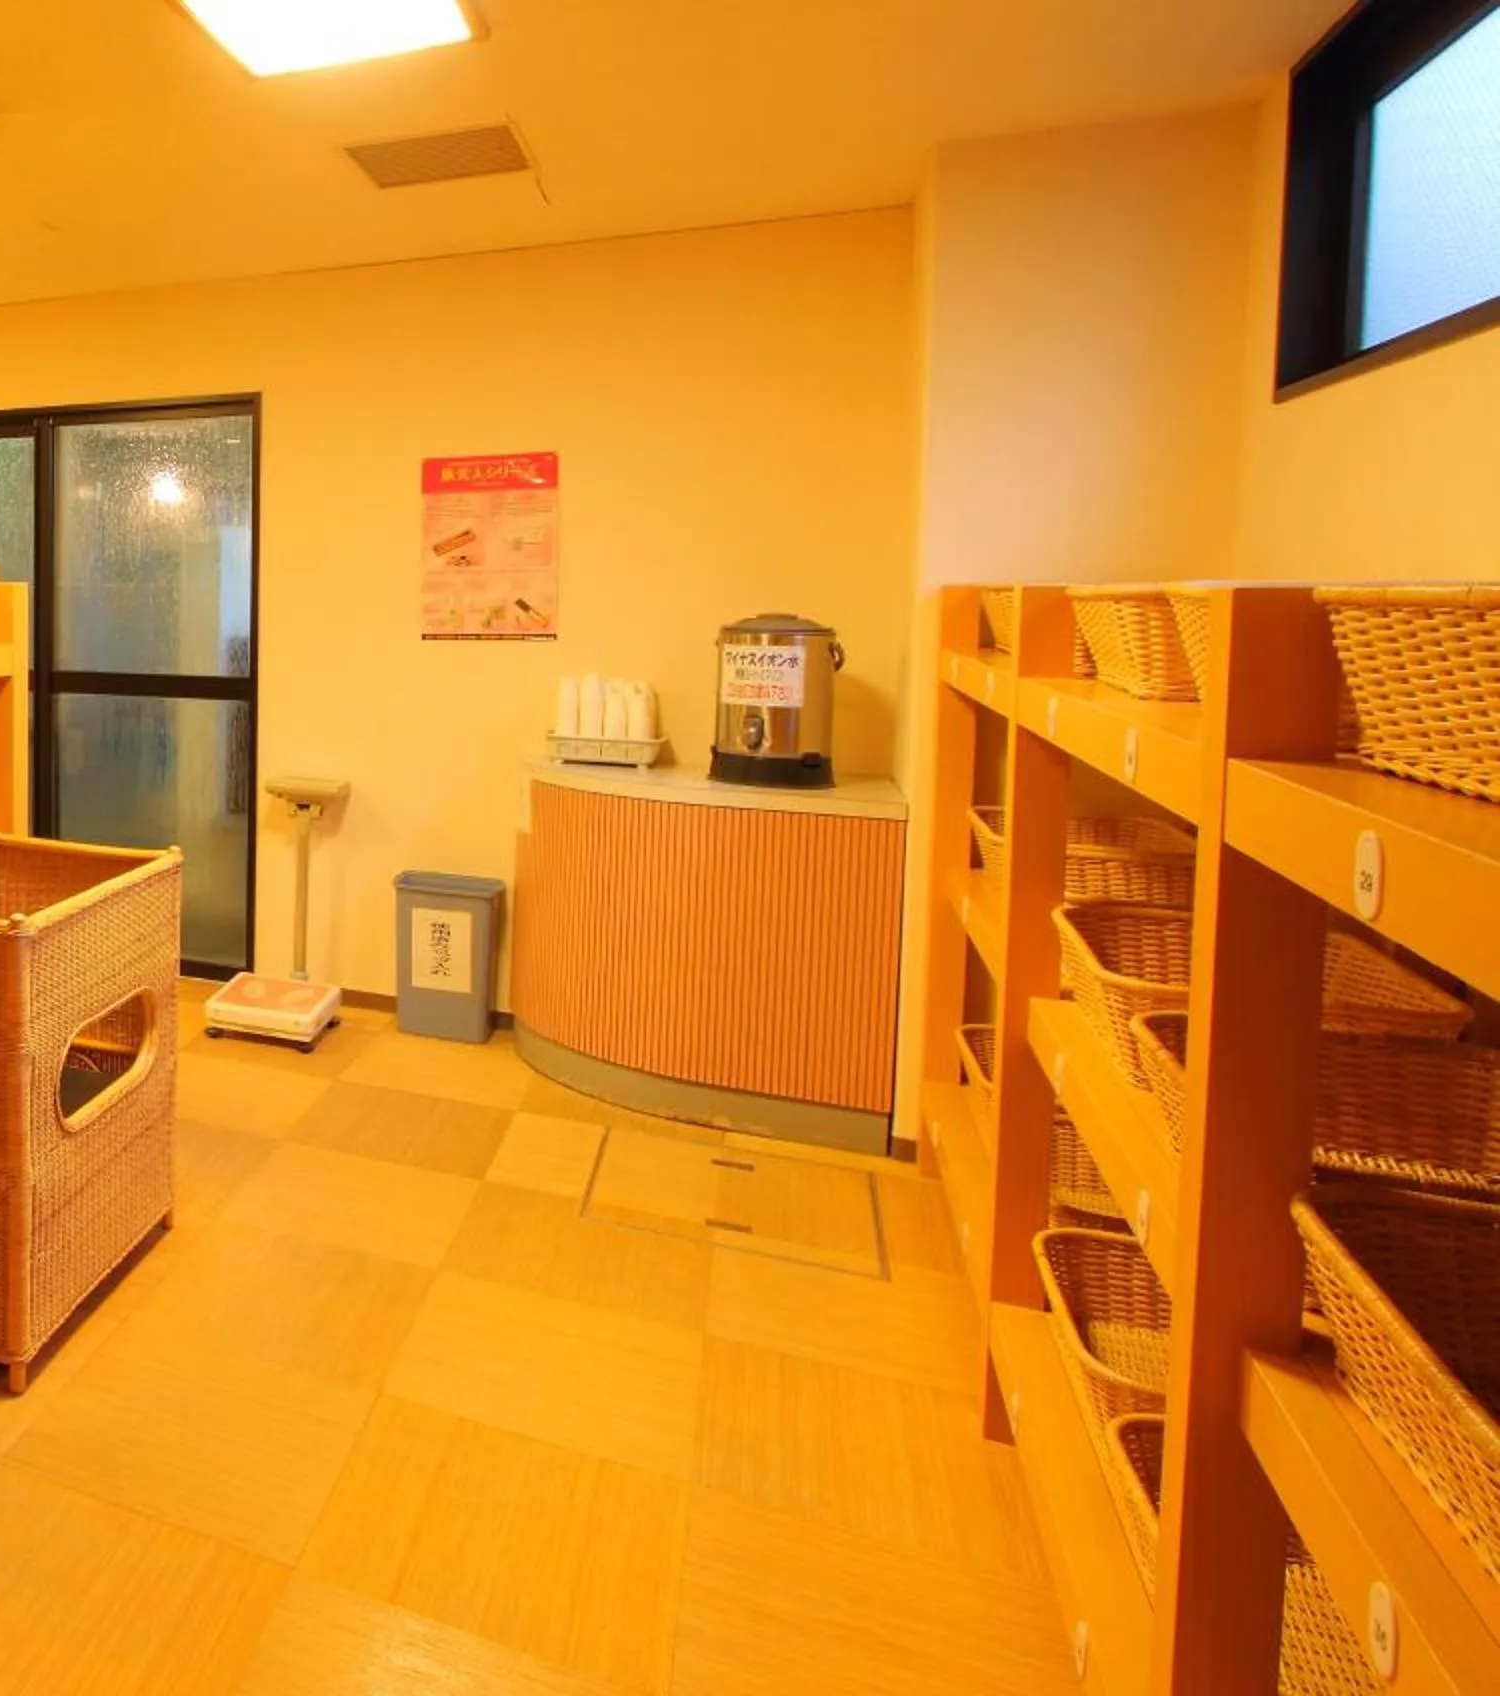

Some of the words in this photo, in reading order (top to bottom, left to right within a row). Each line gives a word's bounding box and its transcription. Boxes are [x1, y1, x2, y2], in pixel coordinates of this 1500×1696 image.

[725, 650, 800, 669] マイナスイオン水
